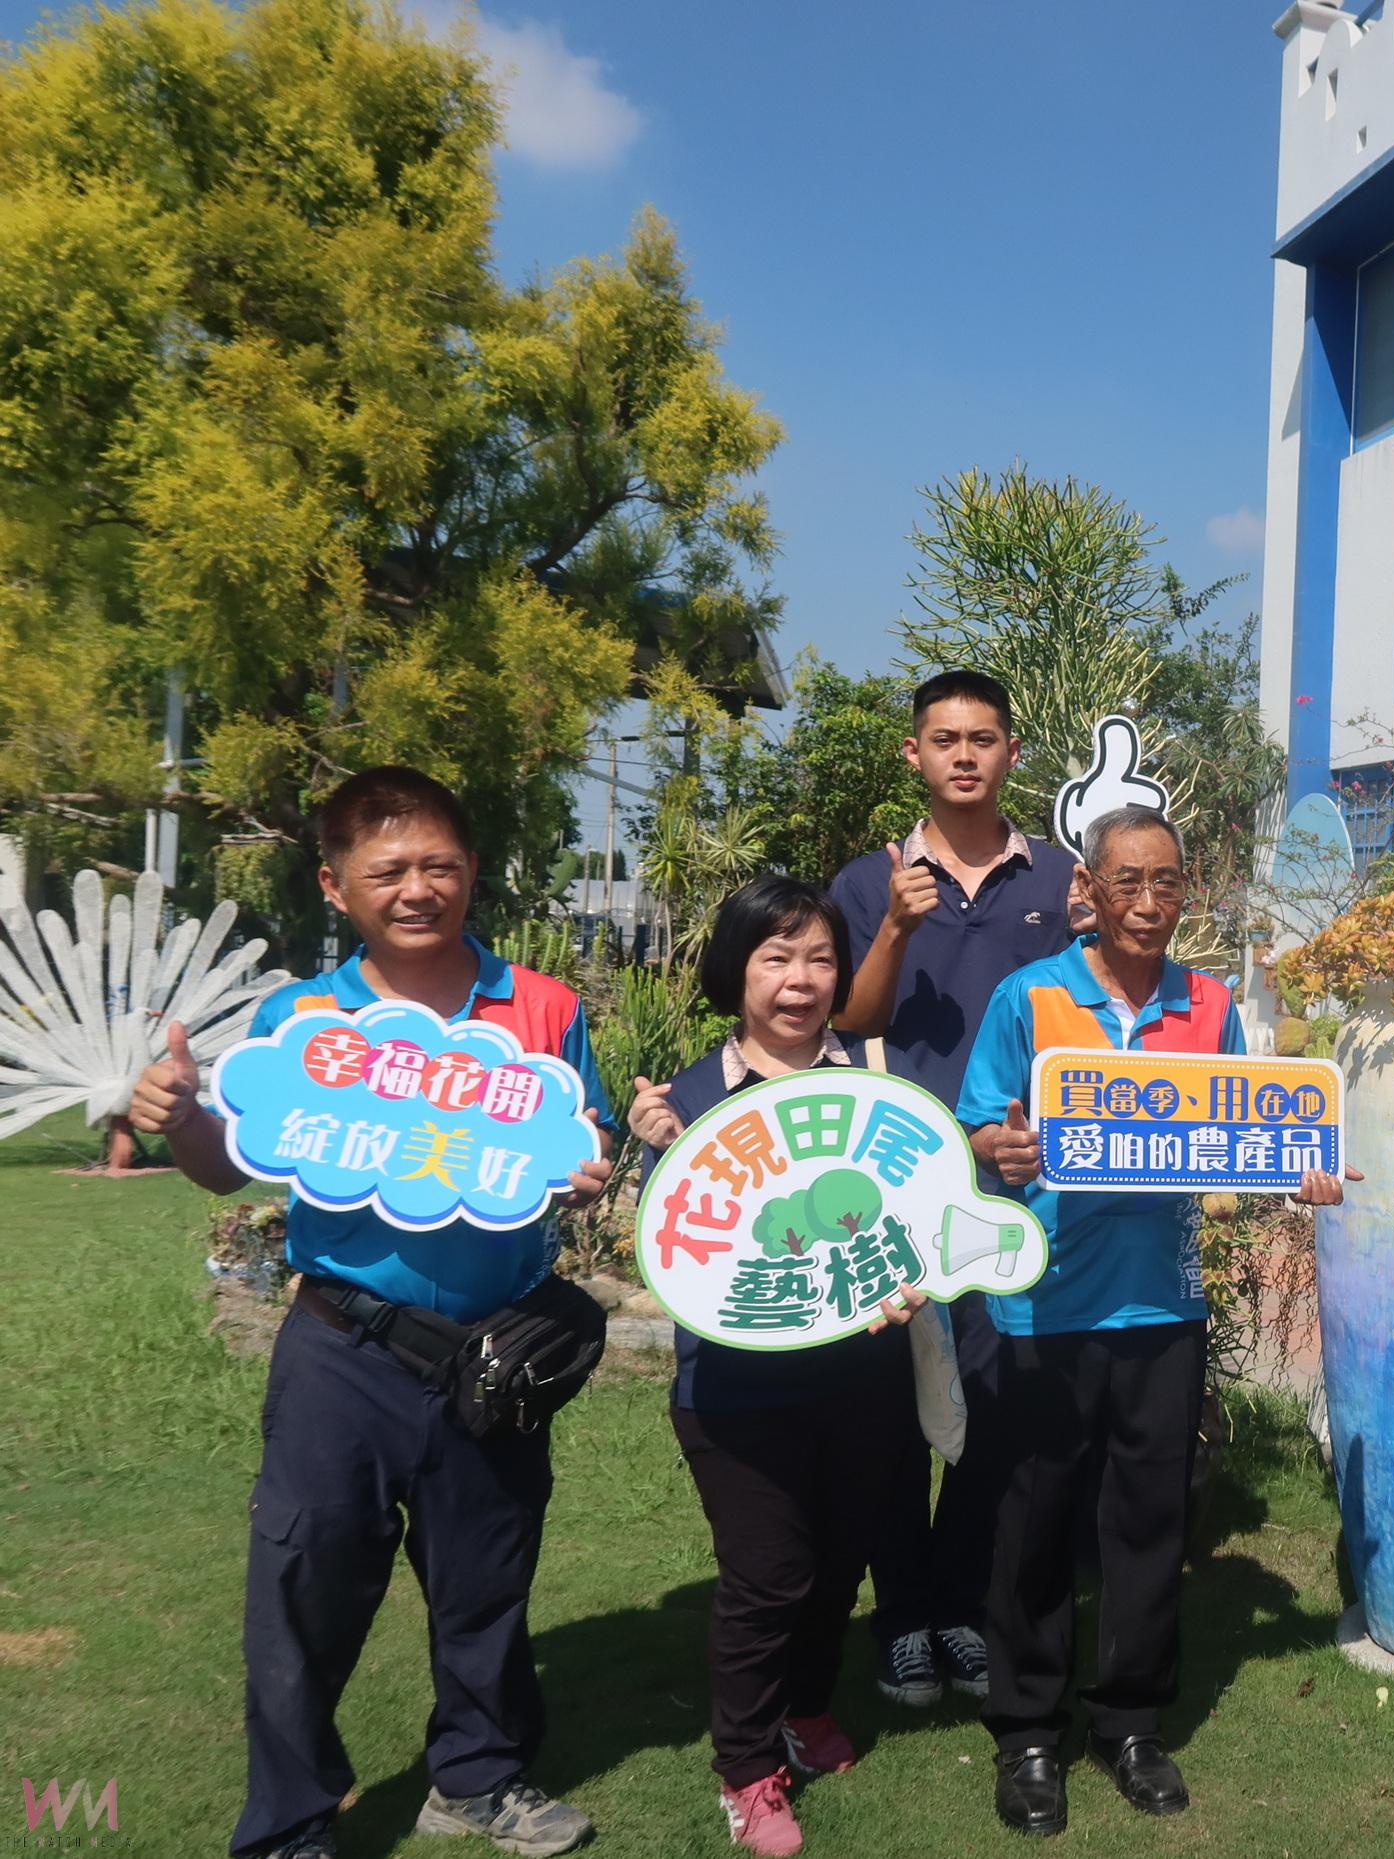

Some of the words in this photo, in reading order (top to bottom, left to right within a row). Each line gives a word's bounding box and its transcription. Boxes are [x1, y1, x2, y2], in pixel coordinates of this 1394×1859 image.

[306, 1028, 542, 1121] 幸福花開
[1059, 1069, 1325, 1122] 買當季、用在地
[274, 1107, 533, 1199] 綻放美好
[655, 1094, 944, 1269] 花現田尾
[1058, 1122, 1323, 1173] 愛咱的農產品
[717, 1215, 924, 1331] 藝樹
